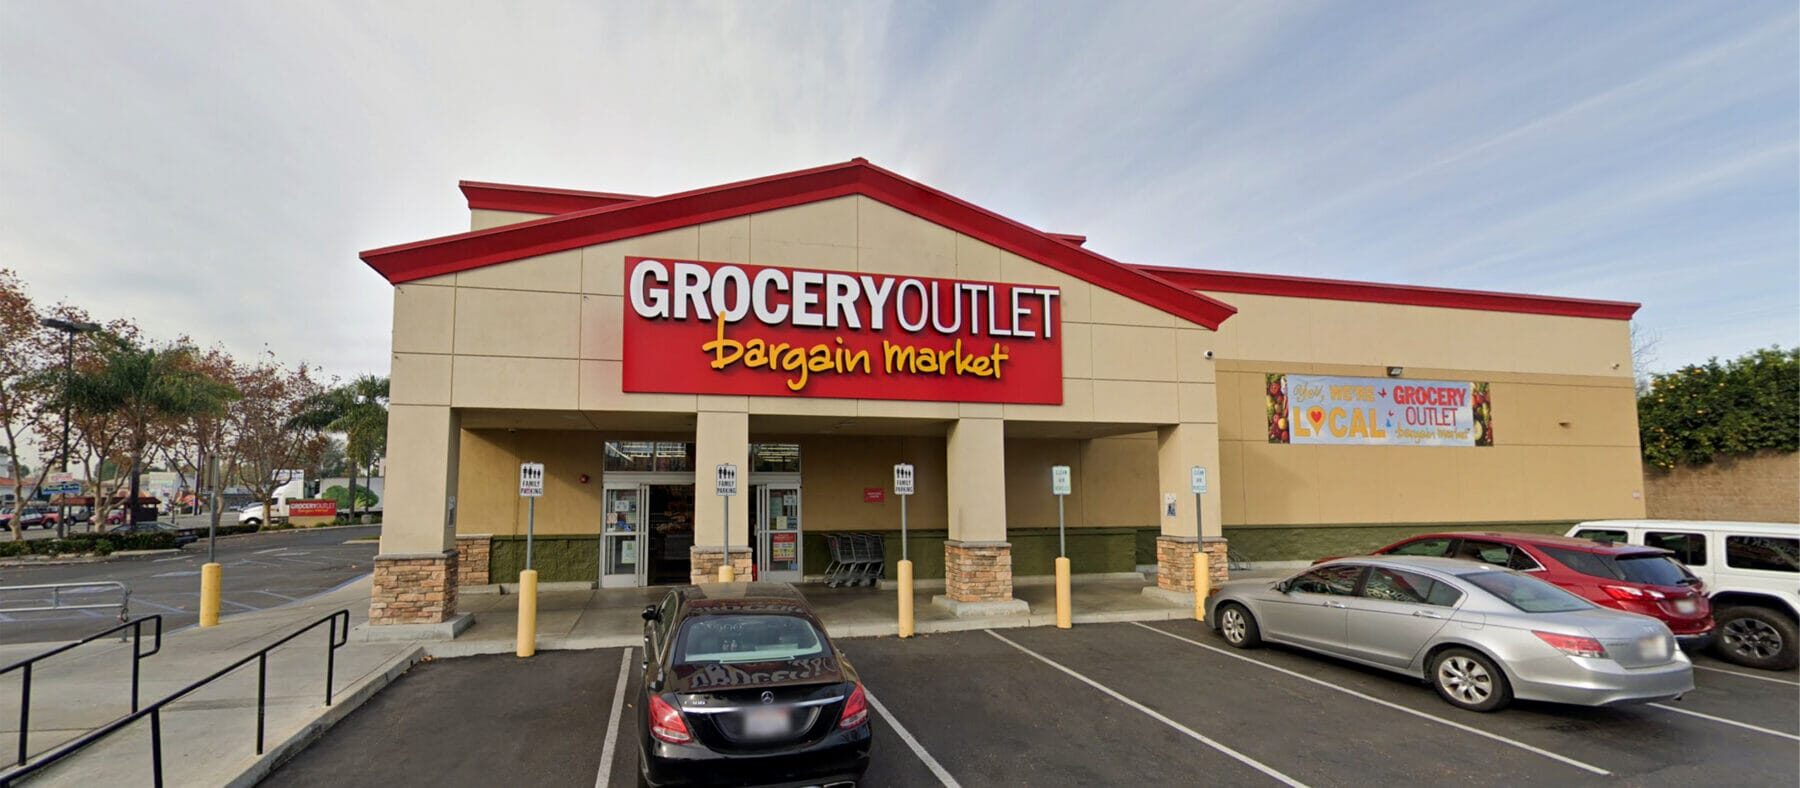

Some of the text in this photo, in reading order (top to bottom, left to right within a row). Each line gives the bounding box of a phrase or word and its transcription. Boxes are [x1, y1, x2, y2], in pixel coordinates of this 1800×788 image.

[702, 311, 871, 391] bargain
[1393, 385, 1466, 407] GROCERY
[1405, 406, 1458, 426] OUTLET
